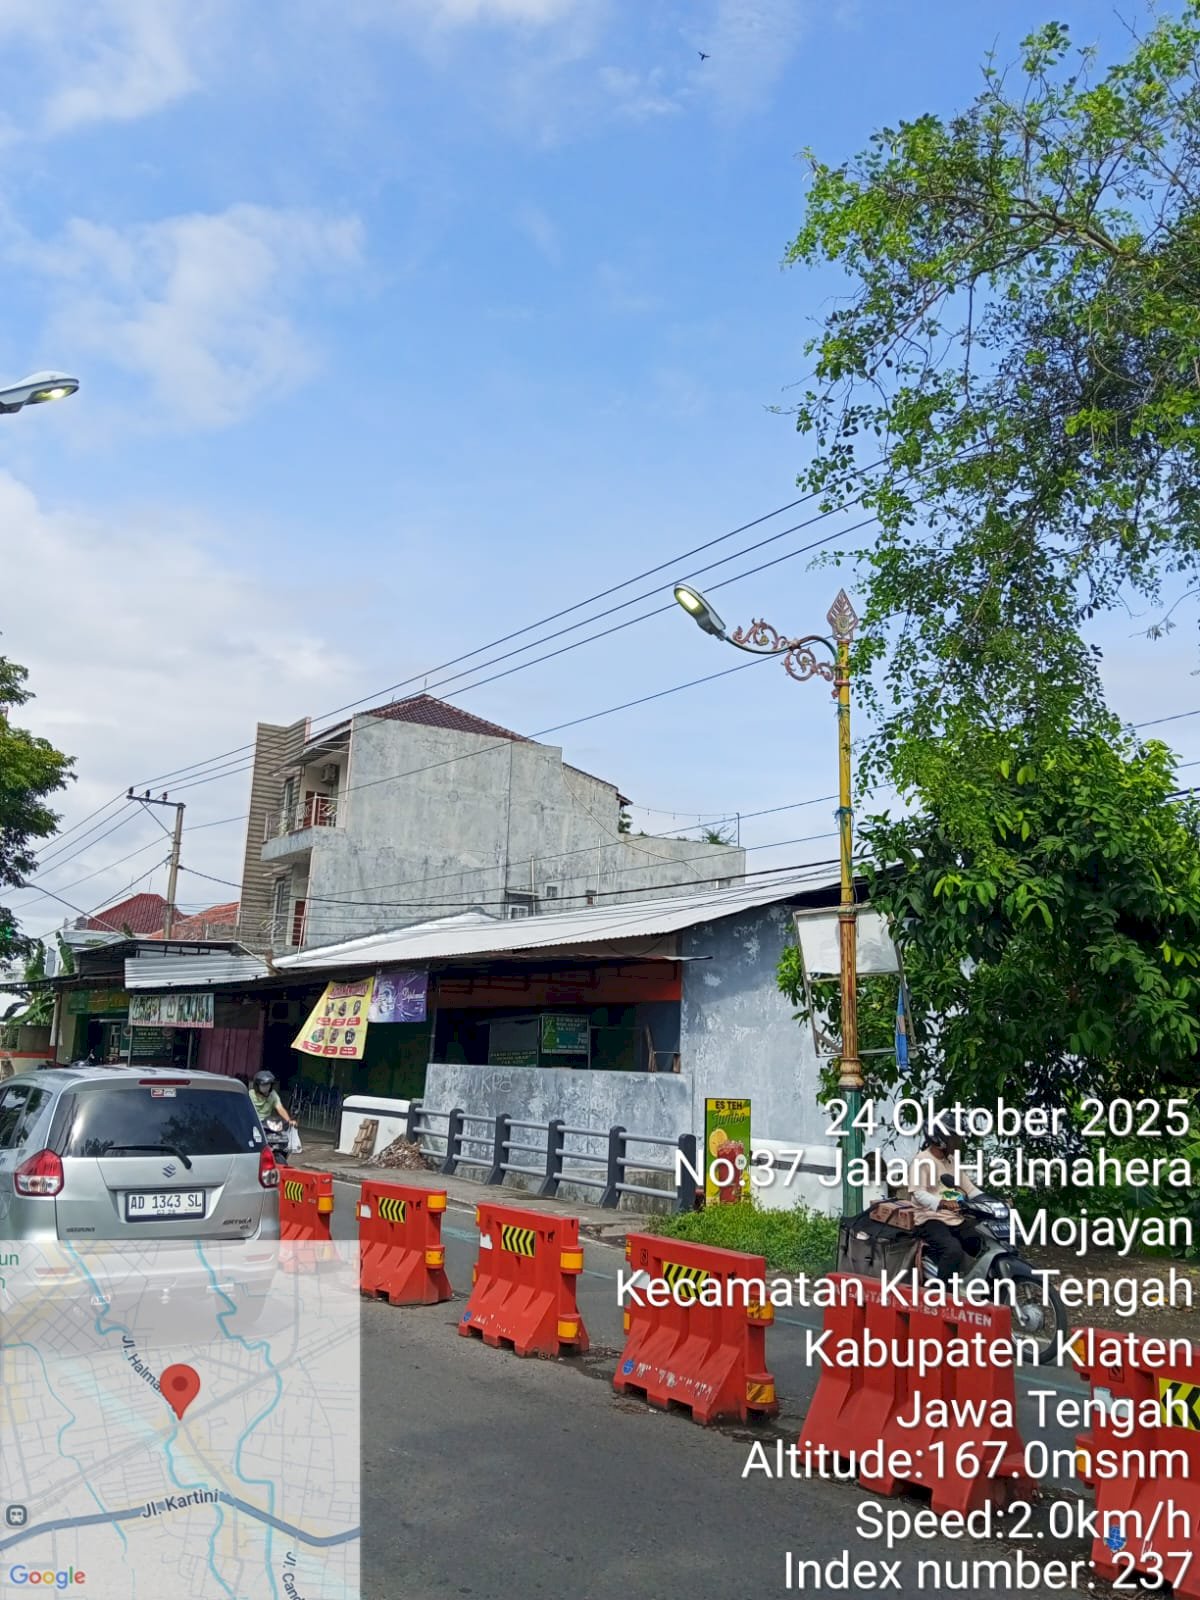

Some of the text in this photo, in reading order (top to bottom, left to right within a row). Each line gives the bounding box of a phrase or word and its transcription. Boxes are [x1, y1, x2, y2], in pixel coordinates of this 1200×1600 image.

[715, 1101, 743, 1110] ES TEH
[130, 1193, 202, 1209] AD 1343 SL
